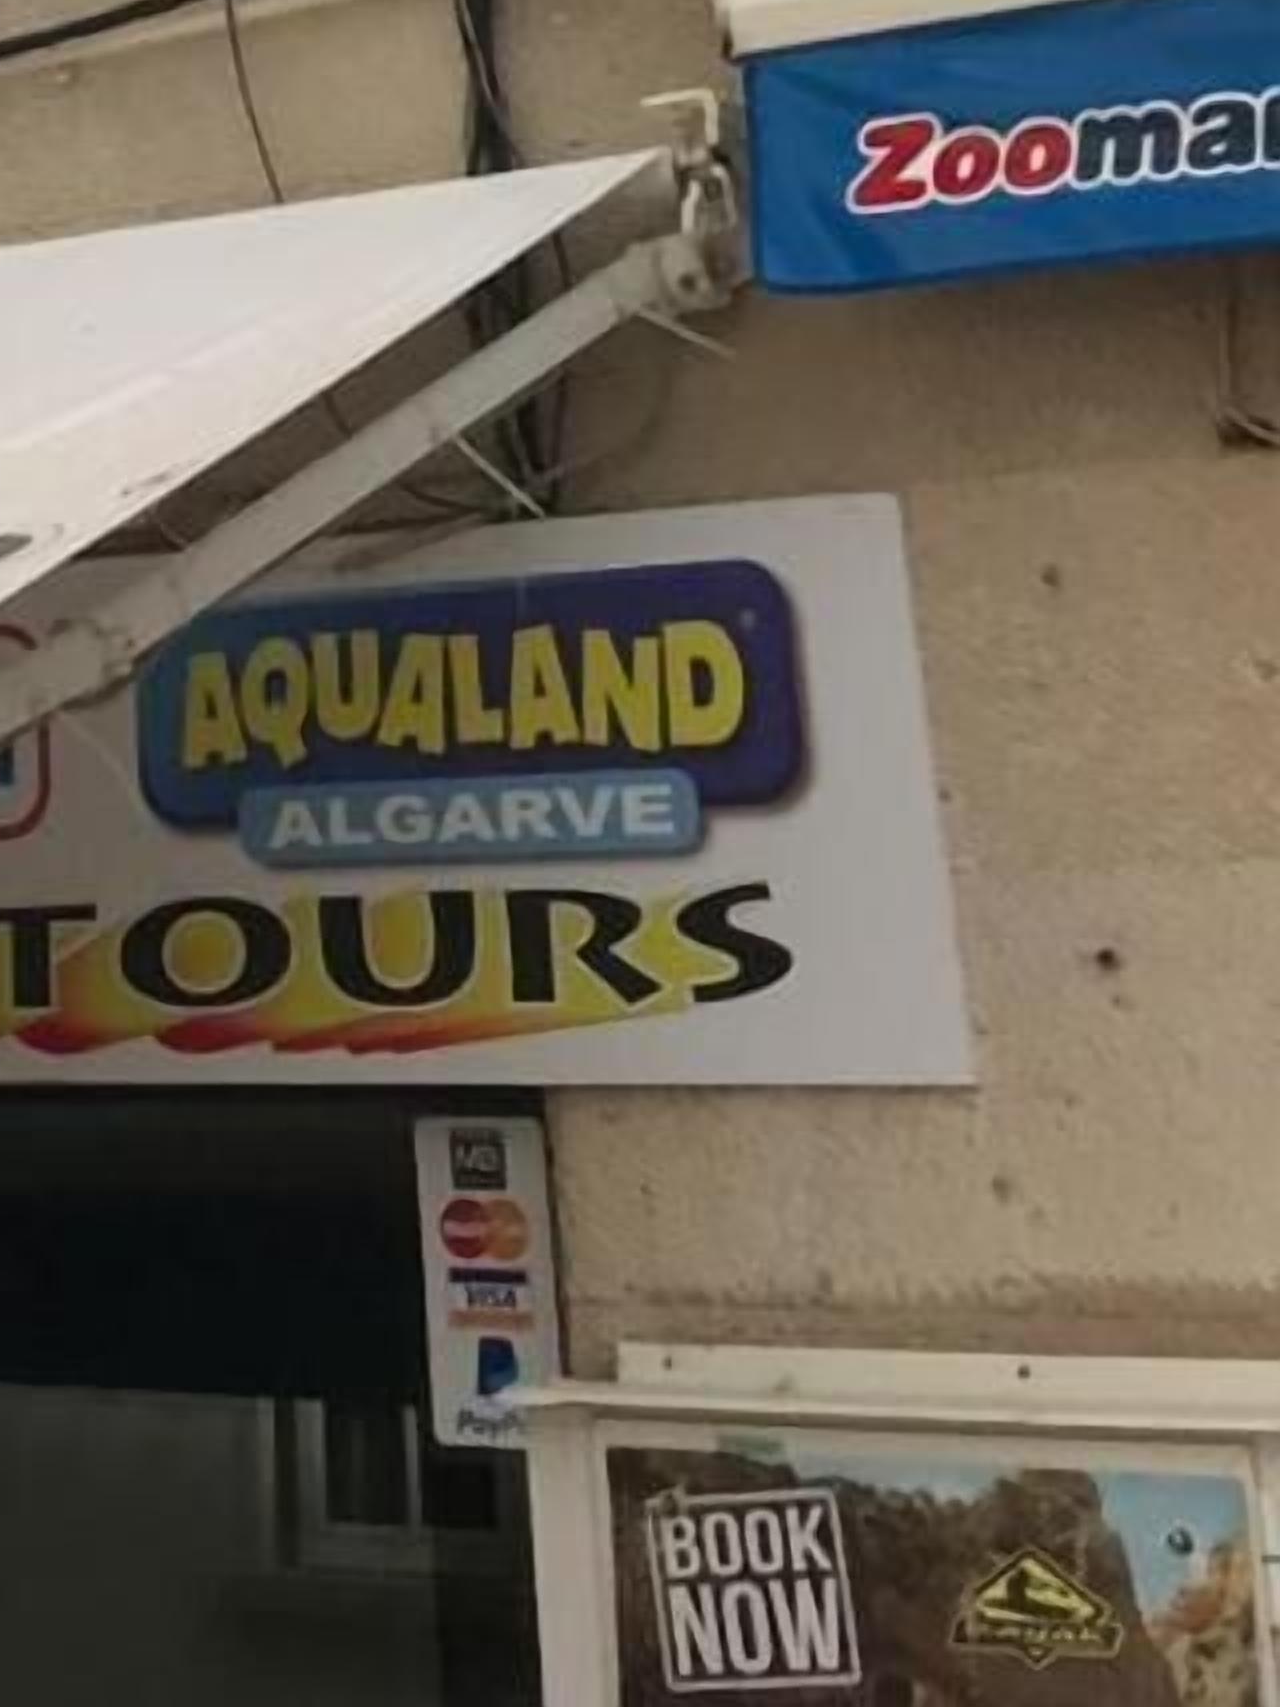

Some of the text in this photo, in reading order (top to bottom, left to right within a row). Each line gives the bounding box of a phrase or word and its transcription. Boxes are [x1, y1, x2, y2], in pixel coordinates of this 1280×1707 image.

[181, 619, 744, 770] AQUALAND
[268, 784, 675, 850] ALGARVE
[660, 1505, 833, 1579] BOOK
[668, 1577, 838, 1677] NOW
